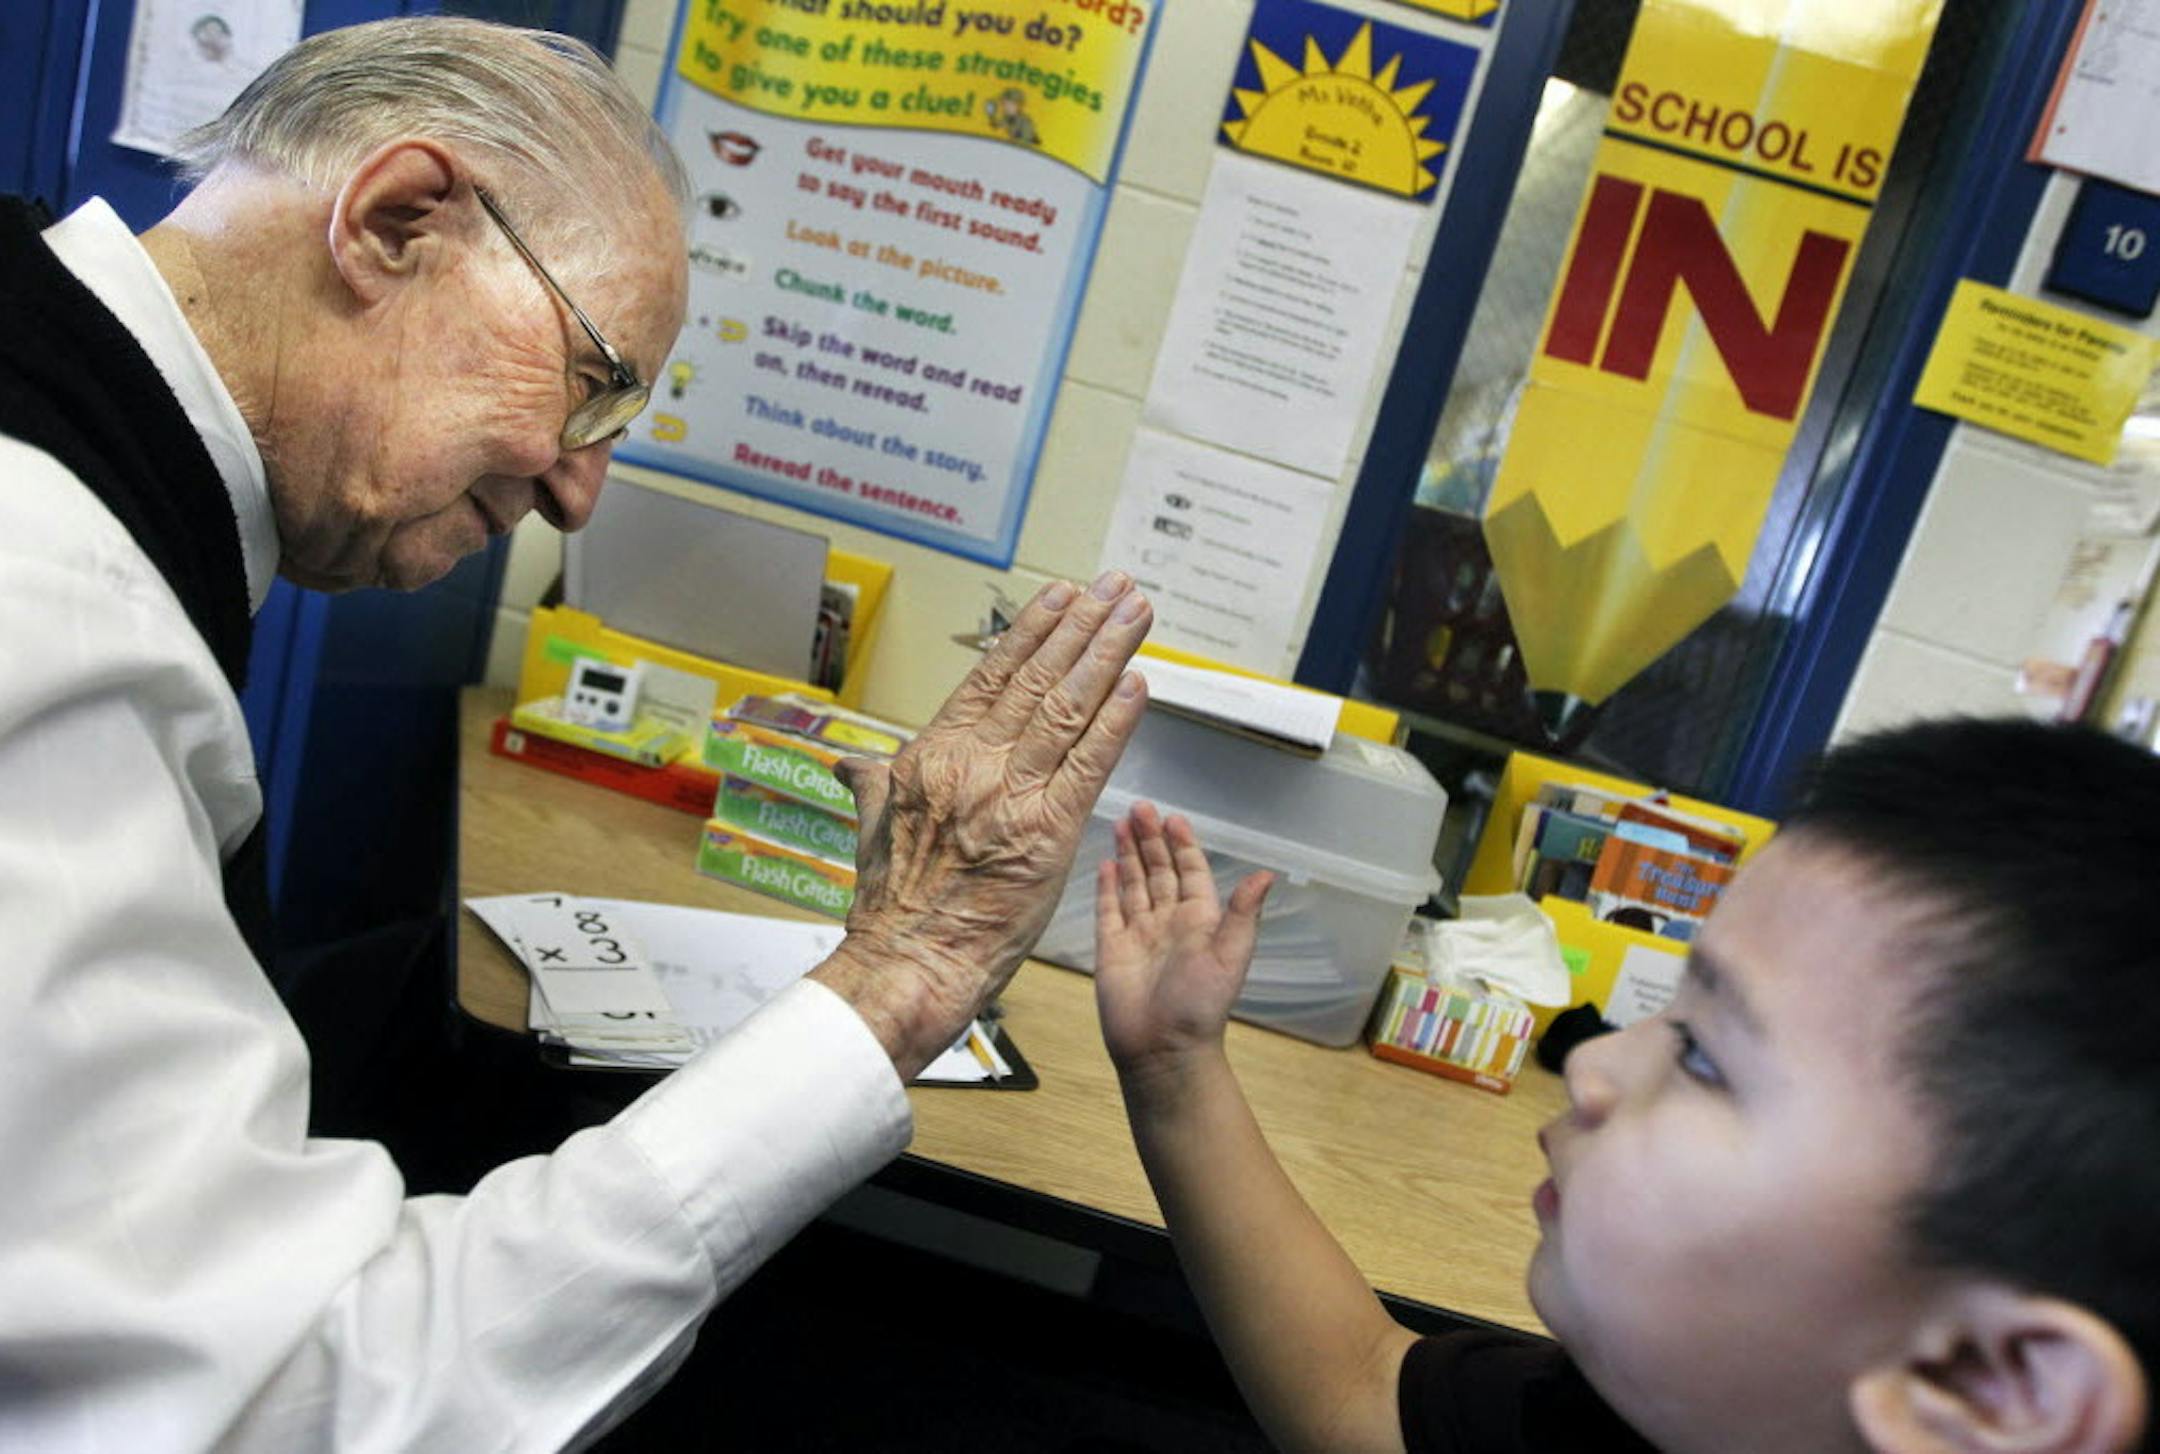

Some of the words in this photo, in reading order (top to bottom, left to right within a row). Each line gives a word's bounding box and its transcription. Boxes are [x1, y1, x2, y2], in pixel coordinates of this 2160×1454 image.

[704, 0, 748, 43] Try
[755, 27, 811, 57] one
[819, 34, 856, 62] of
[861, 38, 945, 71] these
[955, 52, 1103, 112] strategies
[840, 0, 946, 27] should
[953, 10, 1016, 37] you
[1024, 13, 1083, 51] do?
[694, 39, 722, 72] to
[729, 60, 793, 98] give
[801, 83, 860, 110] you
[869, 90, 890, 110] a
[900, 81, 976, 117] clue!
[1614, 80, 1816, 173] SCHOOL
[1831, 143, 1884, 190] IS
[797, 172, 821, 192] to
[827, 181, 867, 210] say
[872, 190, 911, 217] the
[915, 200, 963, 231] first
[968, 218, 1045, 254] sound.
[805, 136, 847, 165] Get
[851, 153, 905, 179] your
[909, 168, 985, 202] mouth
[990, 189, 1058, 227] ready
[785, 219, 842, 250] Look
[847, 236, 872, 258] at
[876, 244, 914, 271] the
[917, 256, 1006, 295] picture.
[2102, 223, 2147, 262] 10
[773, 267, 846, 305] Chunk
[852, 289, 889, 316] the
[895, 303, 958, 336] word.
[1542, 172, 1854, 424] IN
[754, 351, 789, 376] on,
[796, 358, 849, 391] then
[852, 375, 929, 414] reread.
[762, 315, 812, 348] Skip
[818, 332, 856, 359] the
[860, 347, 919, 376] word
[921, 361, 968, 390] and
[969, 374, 1025, 405] read
[744, 394, 805, 430] Think
[810, 415, 877, 450] about
[880, 434, 919, 462] the
[923, 448, 988, 483] story.
[733, 441, 813, 482] Reread
[816, 464, 854, 493] the
[858, 481, 965, 525] sentence.
[741, 743, 791, 781] Flash
[792, 767, 846, 801] Cards
[758, 802, 808, 836] Flash
[809, 817, 859, 855] Cards
[741, 854, 792, 890] Flash
[792, 873, 844, 909] Cards
[574, 911, 609, 935] 8
[589, 937, 627, 964] 3
